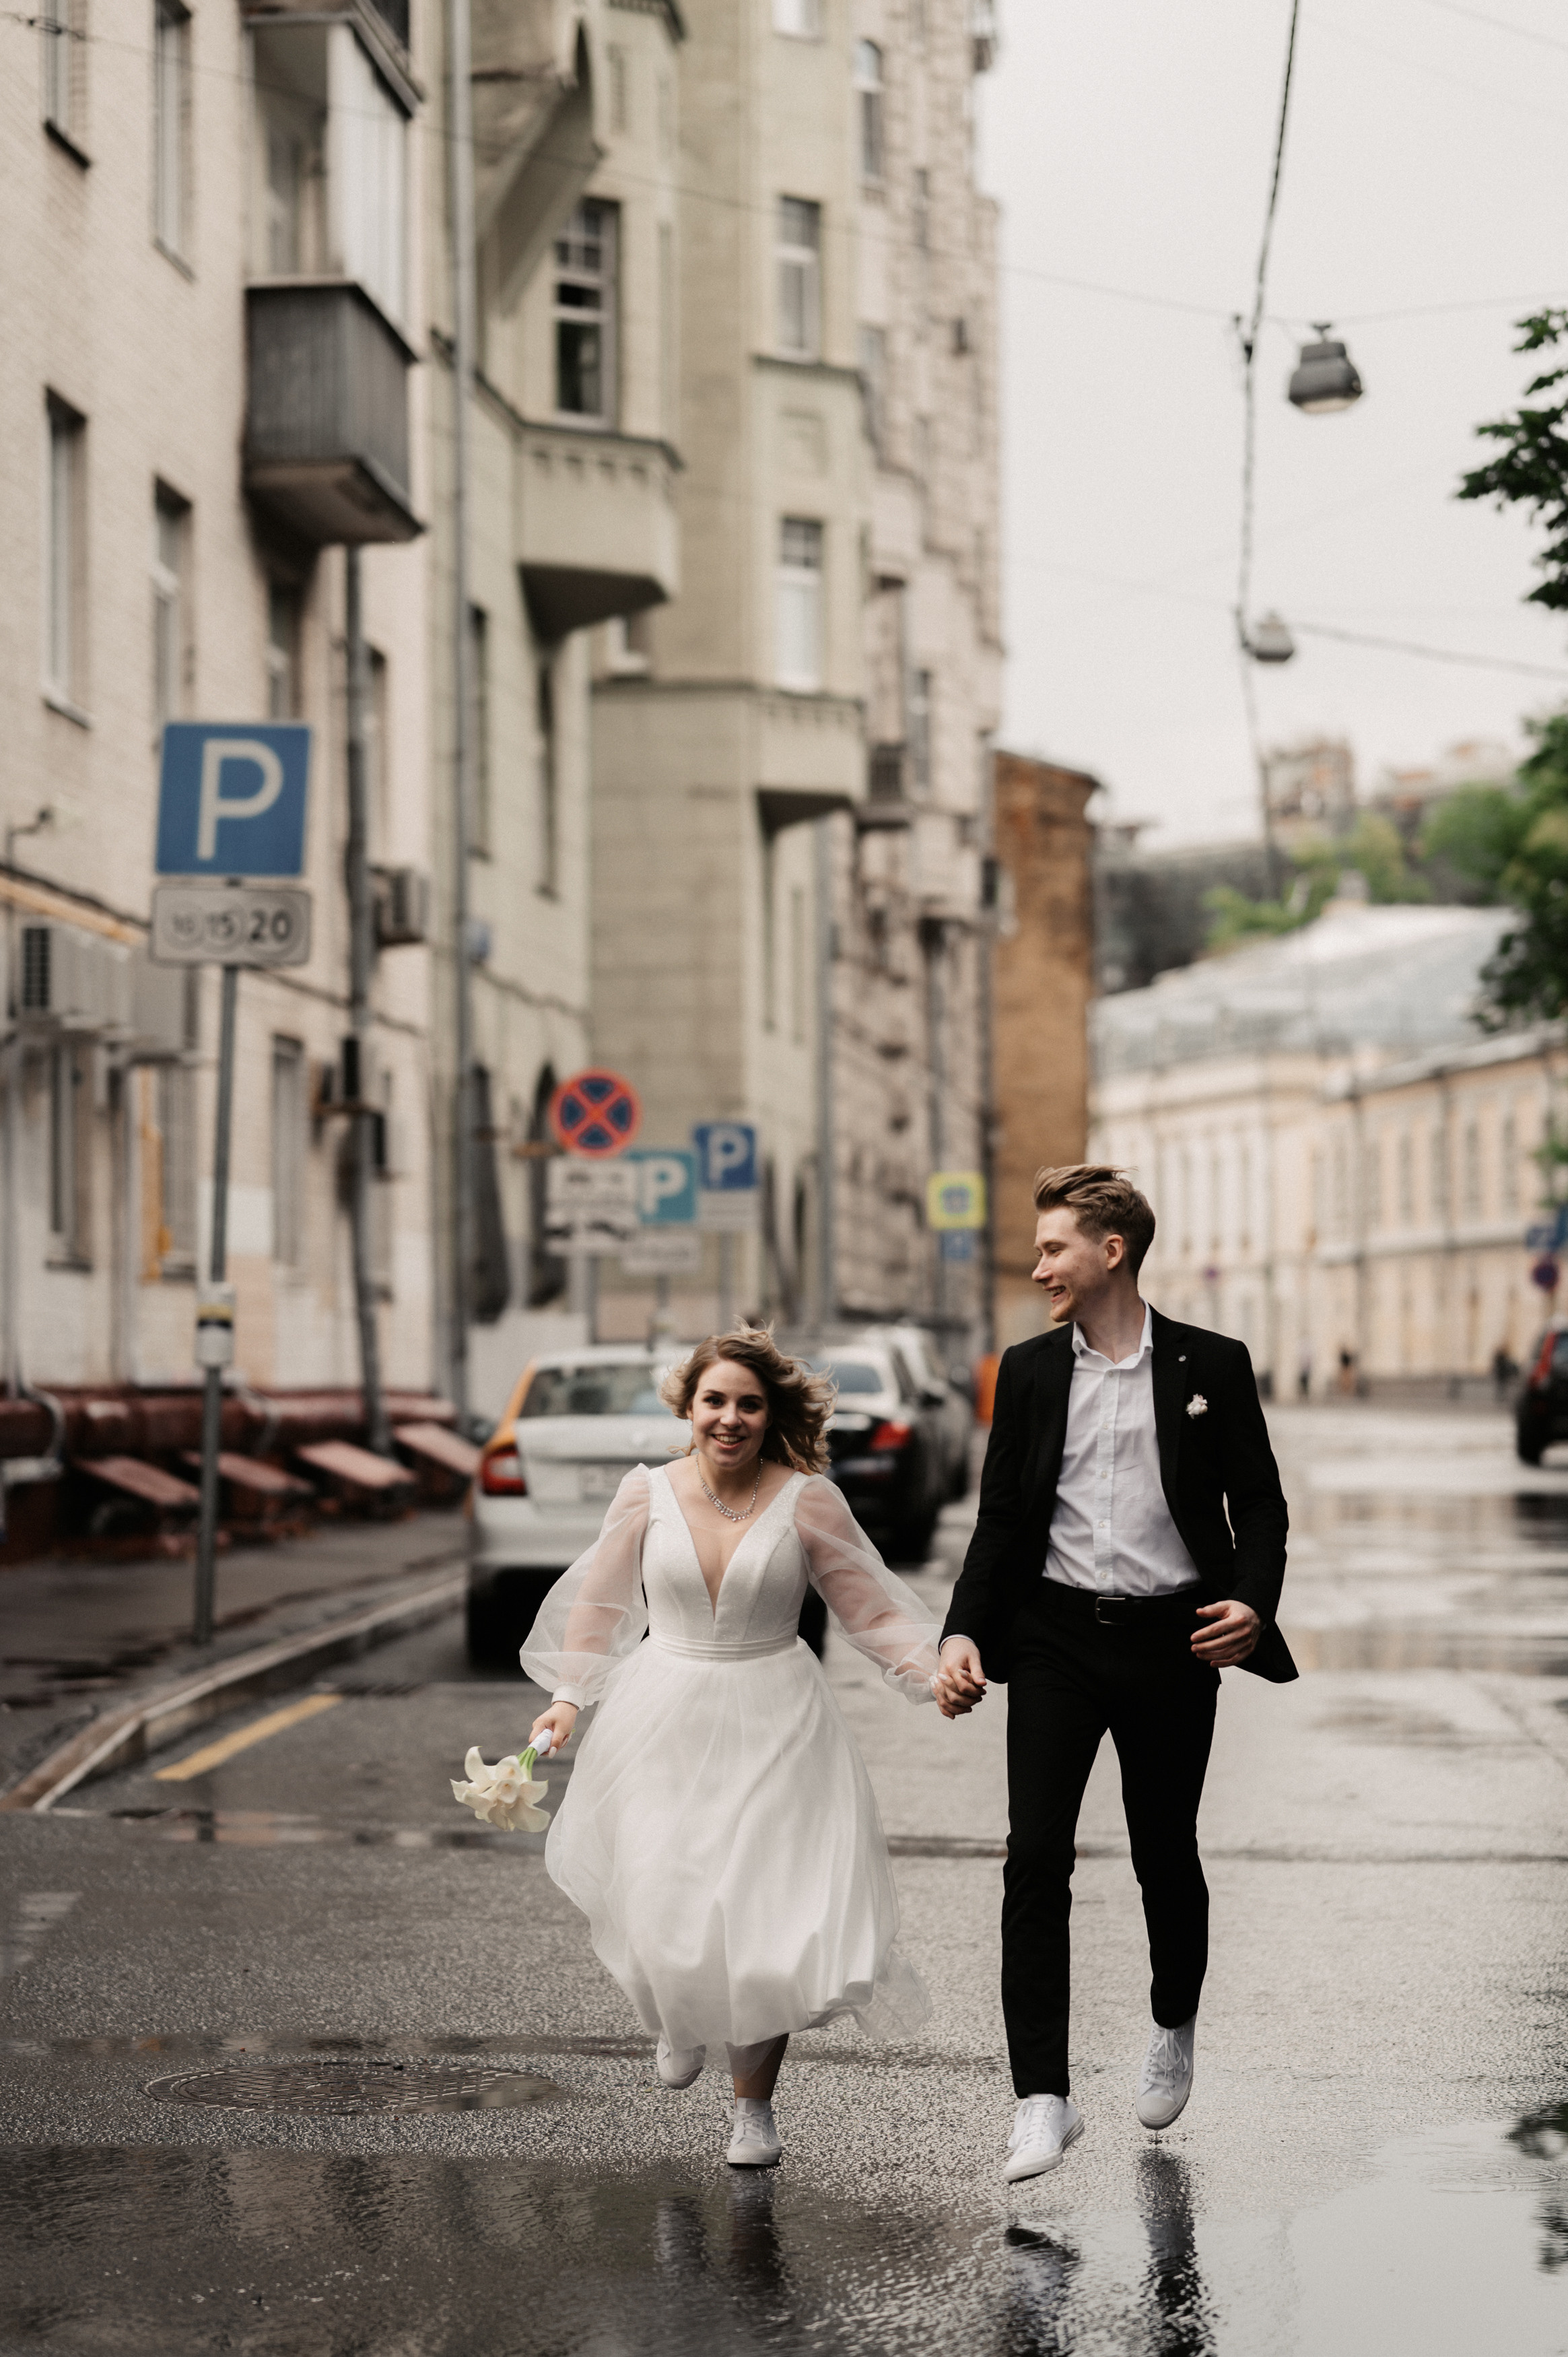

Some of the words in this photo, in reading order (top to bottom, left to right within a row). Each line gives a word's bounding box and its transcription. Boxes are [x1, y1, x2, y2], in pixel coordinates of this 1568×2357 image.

[197, 739, 284, 860] P
[248, 909, 293, 943] 20
[708, 1126, 747, 1186] P
[640, 1158, 687, 1214] P
